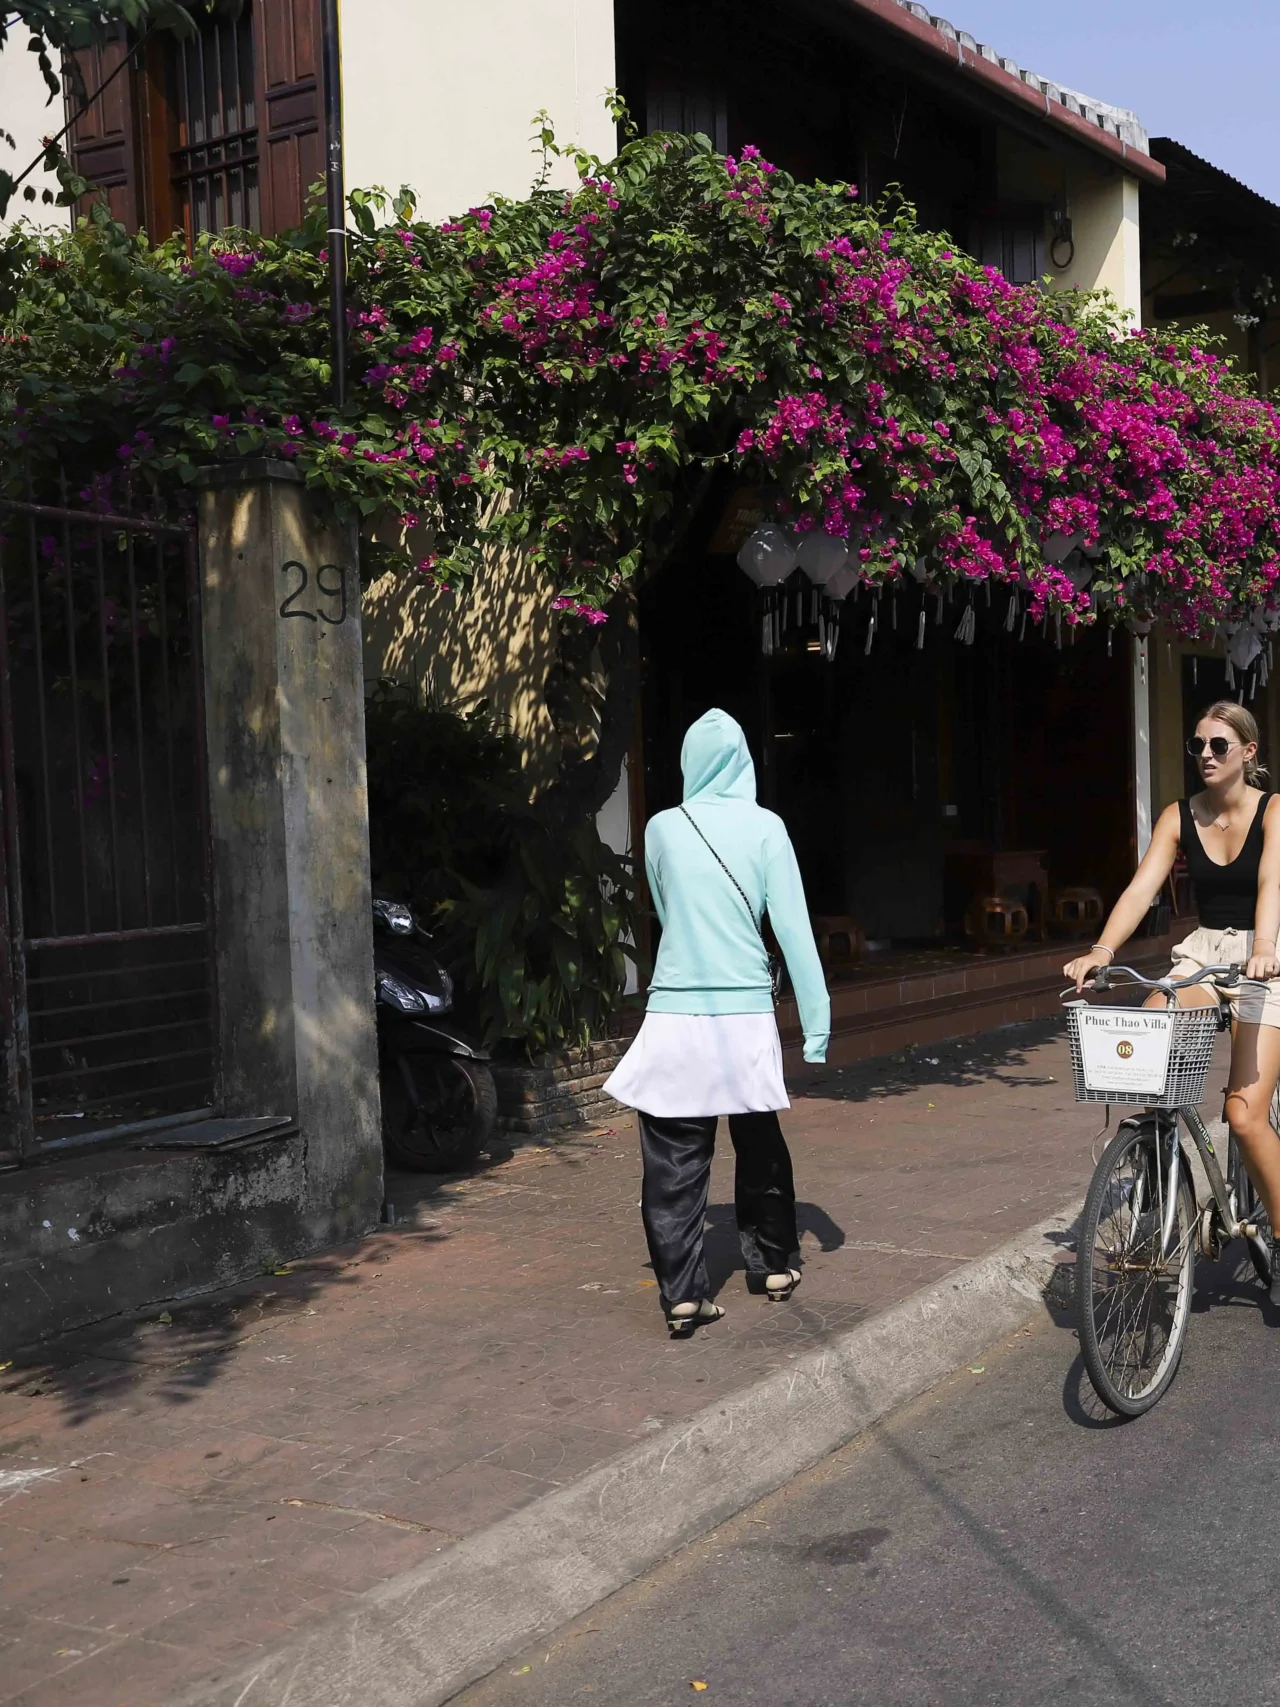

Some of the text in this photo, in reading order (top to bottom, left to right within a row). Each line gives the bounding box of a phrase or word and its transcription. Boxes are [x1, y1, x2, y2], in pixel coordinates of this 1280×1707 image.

[279, 560, 347, 625] 29
[1085, 1015, 1167, 1030] Phuc Thao Villa
[1117, 1044, 1133, 1055] 08
